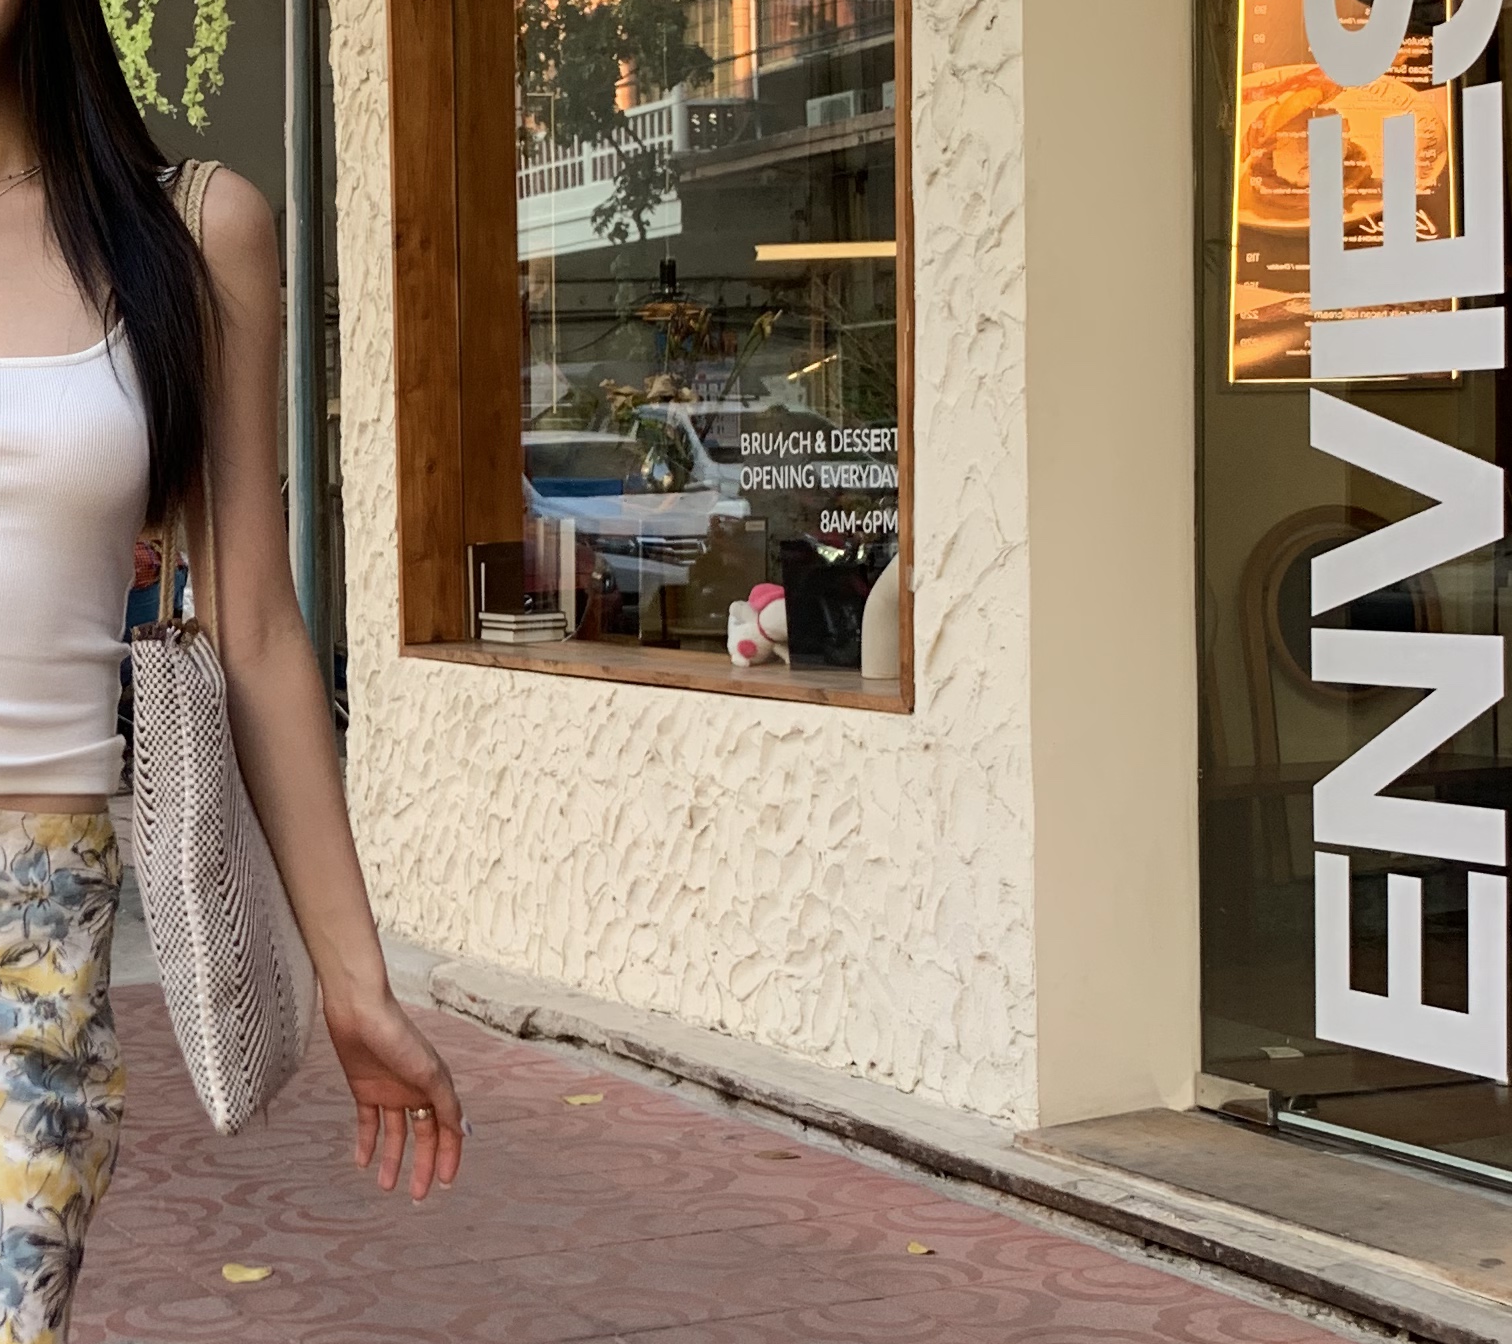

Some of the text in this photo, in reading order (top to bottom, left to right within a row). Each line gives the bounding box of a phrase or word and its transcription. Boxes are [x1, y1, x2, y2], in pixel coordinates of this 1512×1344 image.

[740, 428, 899, 458] BRUNCH & DESSERT
[740, 464, 899, 490] OPENING EVERYDAY
[820, 509, 899, 534] 8AM-6PM
